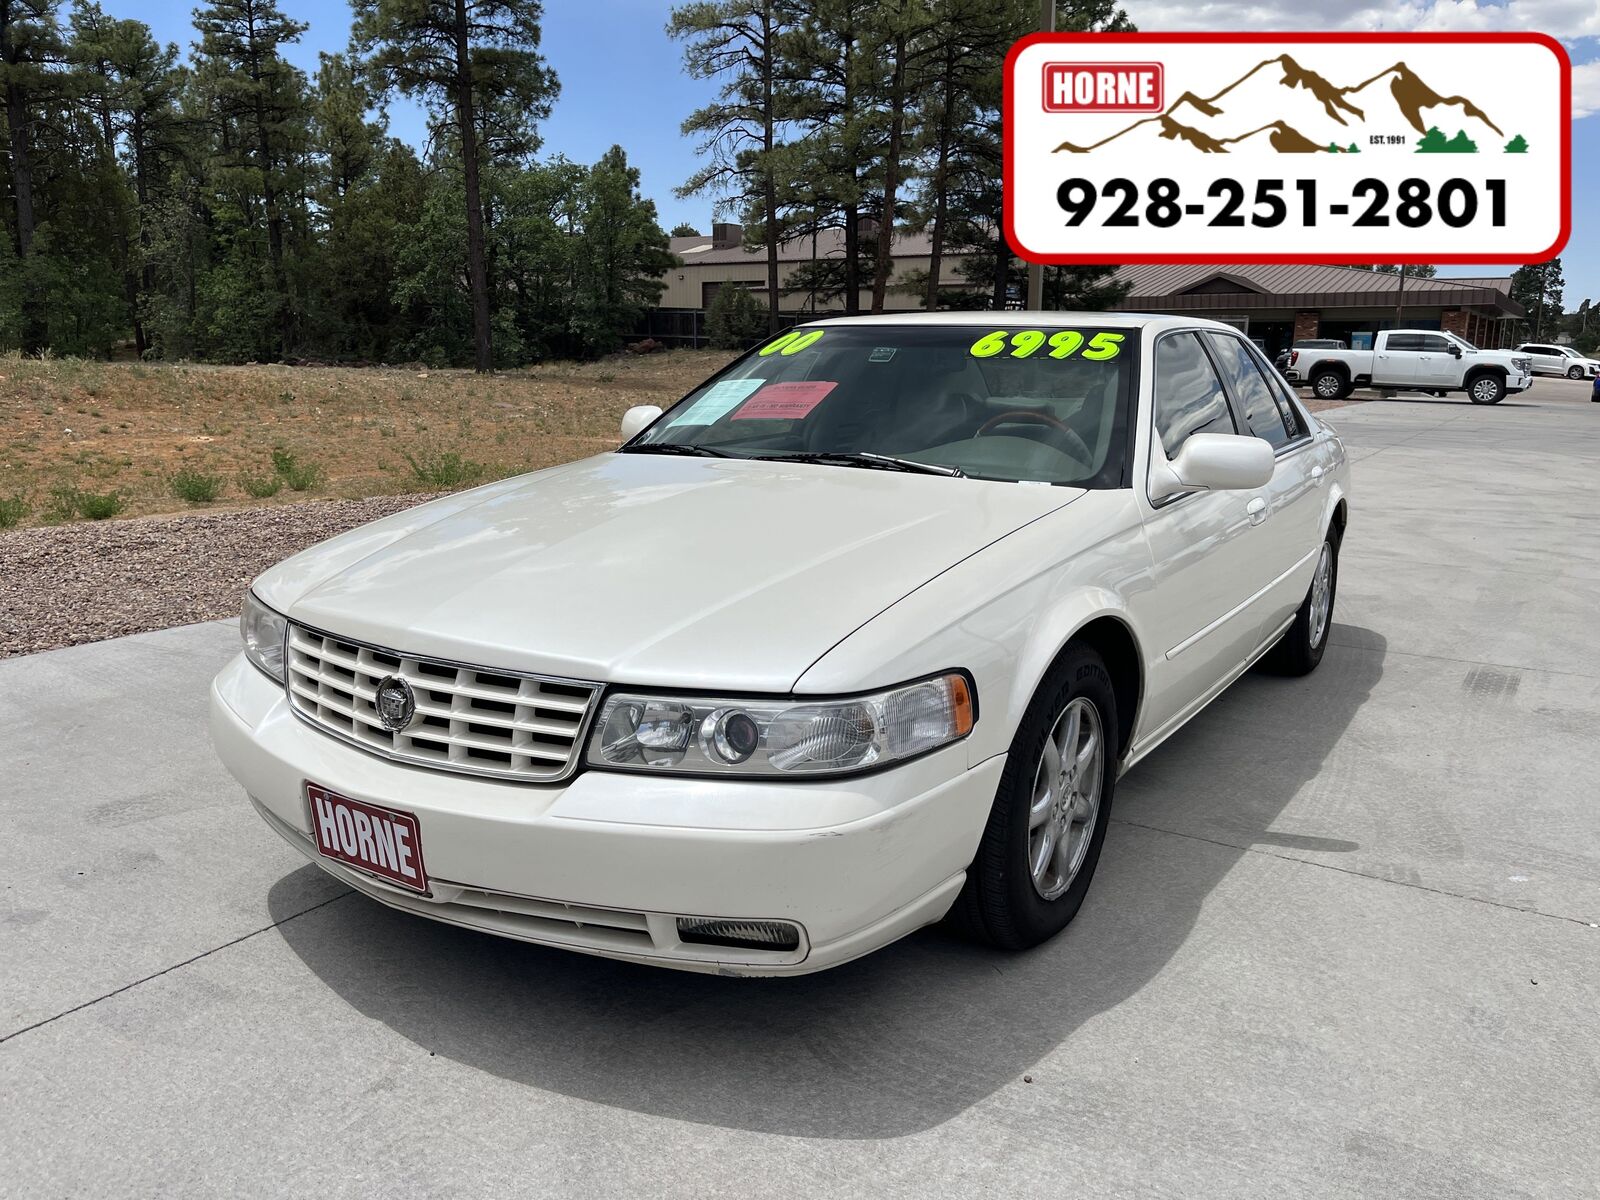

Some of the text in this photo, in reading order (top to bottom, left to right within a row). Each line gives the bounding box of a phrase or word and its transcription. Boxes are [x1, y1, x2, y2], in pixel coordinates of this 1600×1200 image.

[759, 330, 824, 357] 00
[970, 331, 1125, 360] 6995
[315, 797, 417, 879] HORNE
